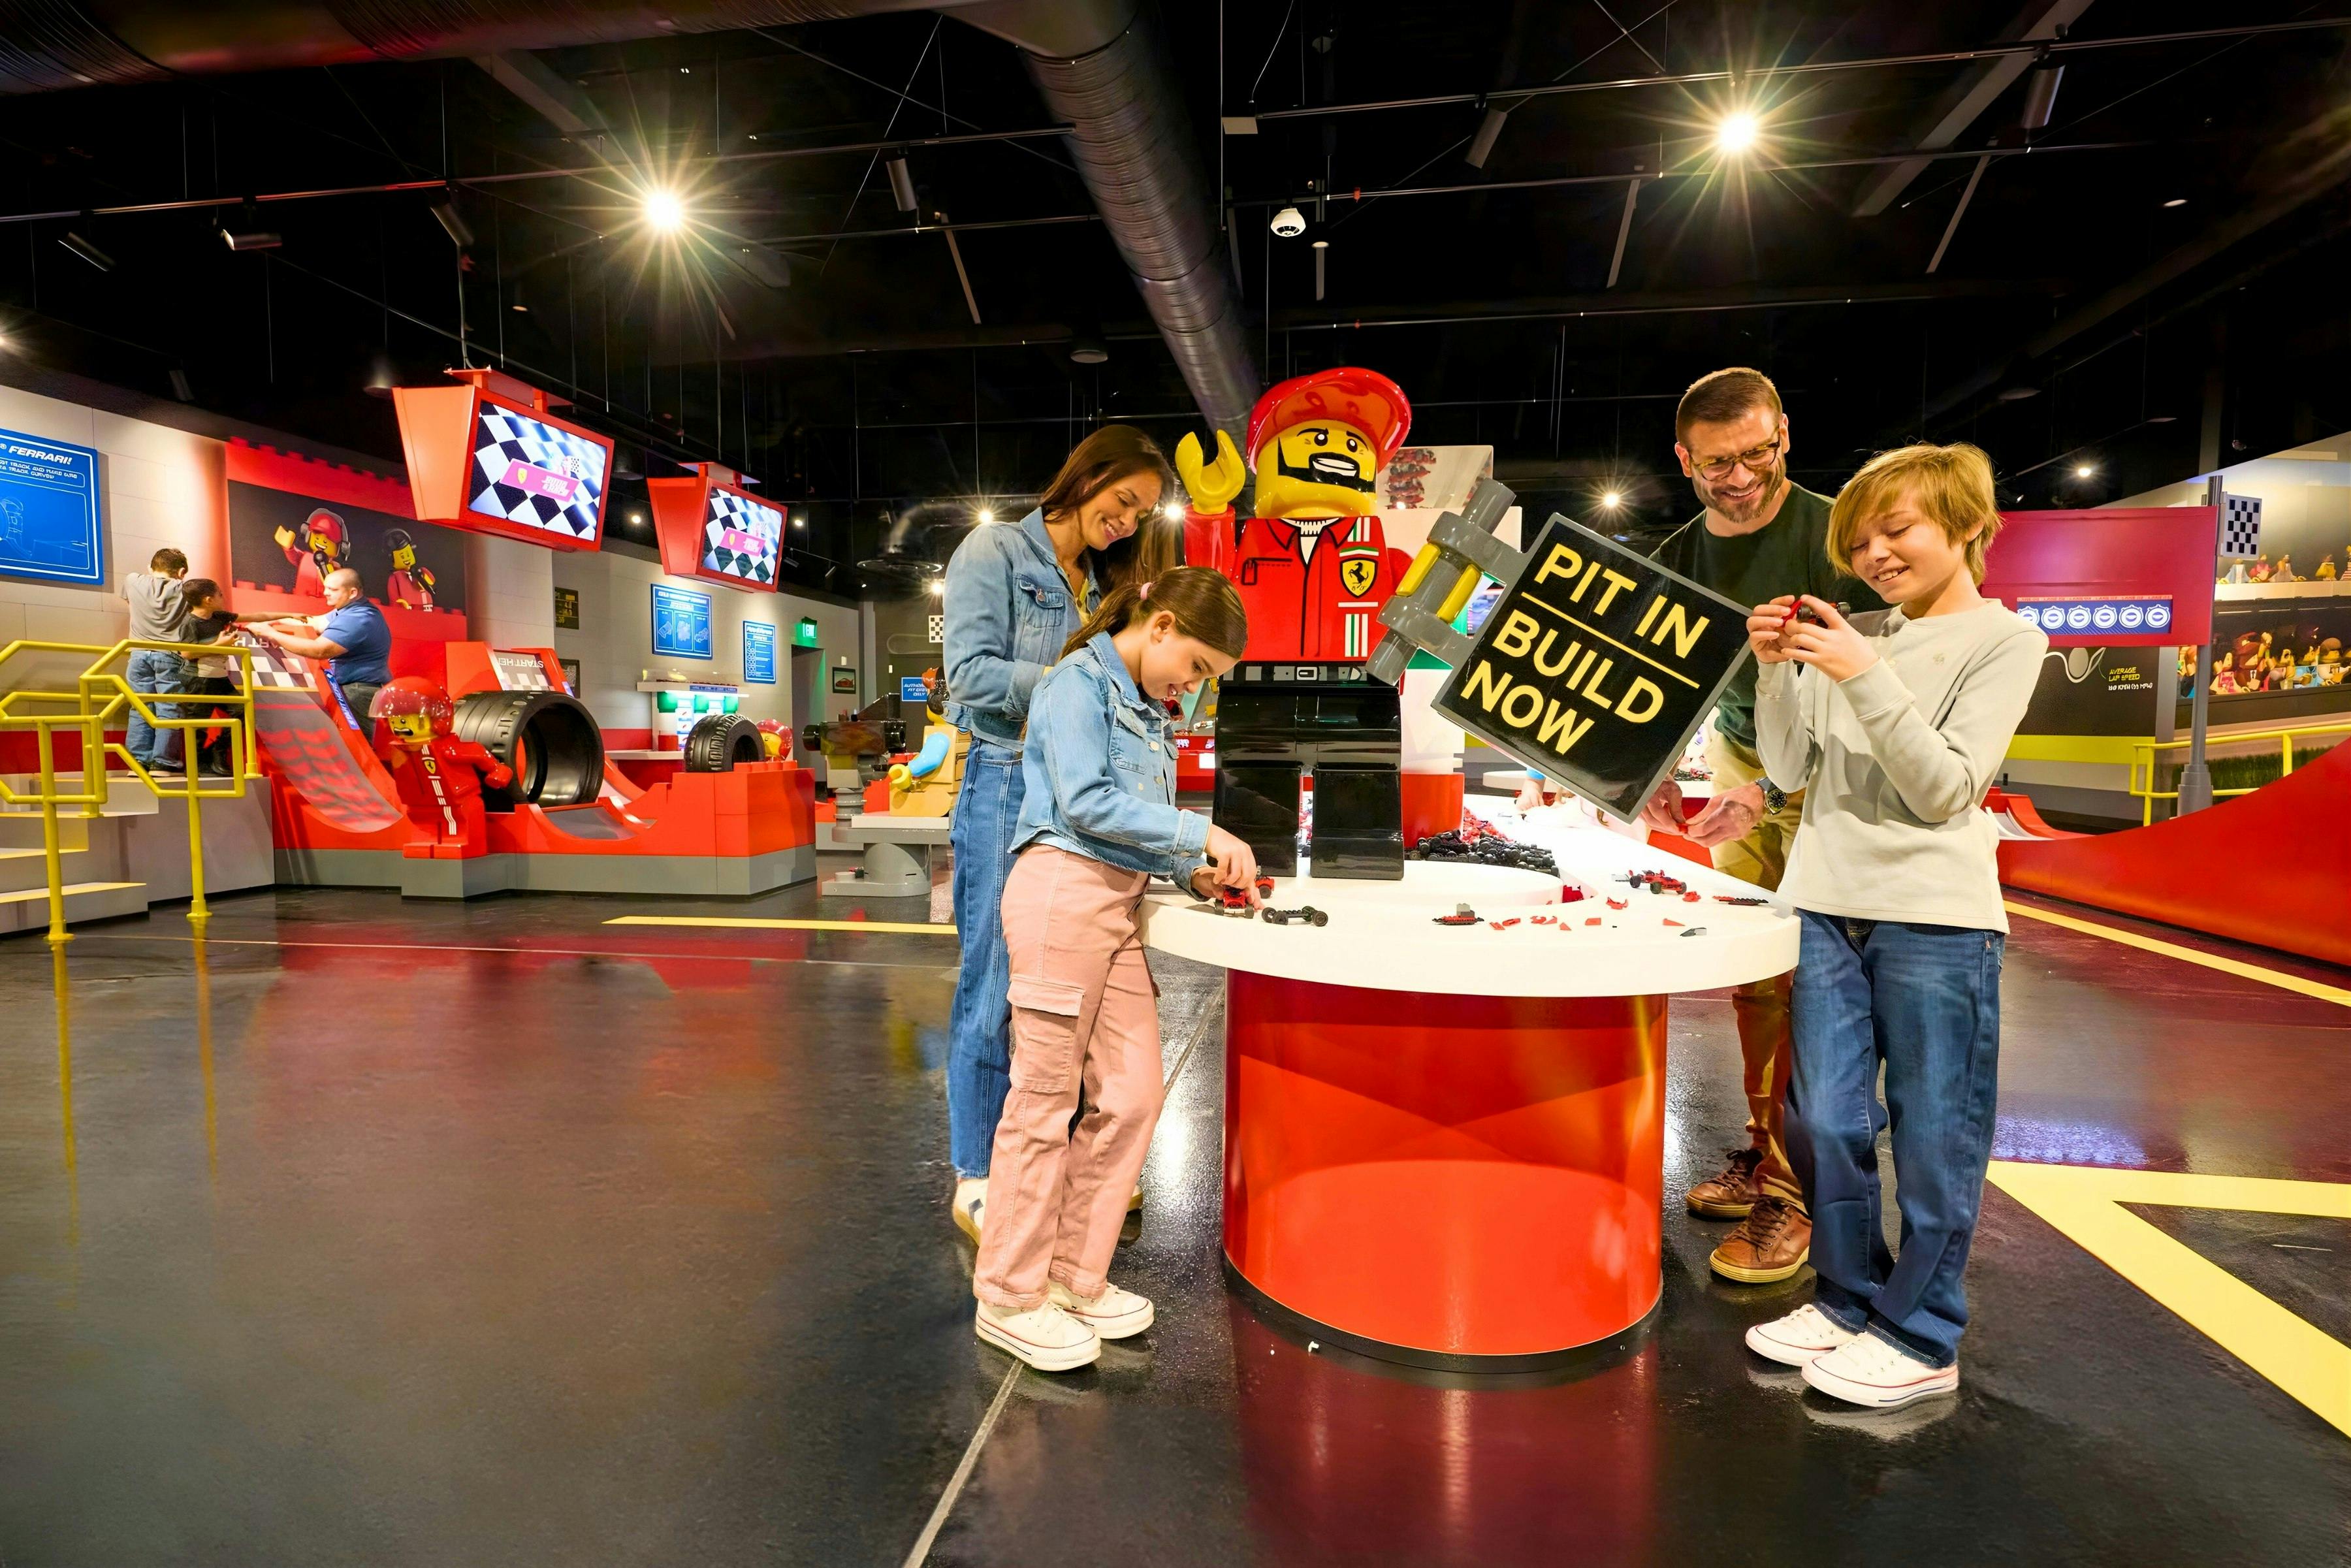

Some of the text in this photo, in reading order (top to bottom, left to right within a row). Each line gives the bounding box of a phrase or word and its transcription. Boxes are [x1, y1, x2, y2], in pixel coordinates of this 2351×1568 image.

[8, 445, 72, 465] FERRARI!
[1534, 543, 1710, 659] PIT IN
[515, 658, 544, 668] START
[1460, 660, 1595, 755] NOW
[1492, 609, 1665, 723] BUILD
